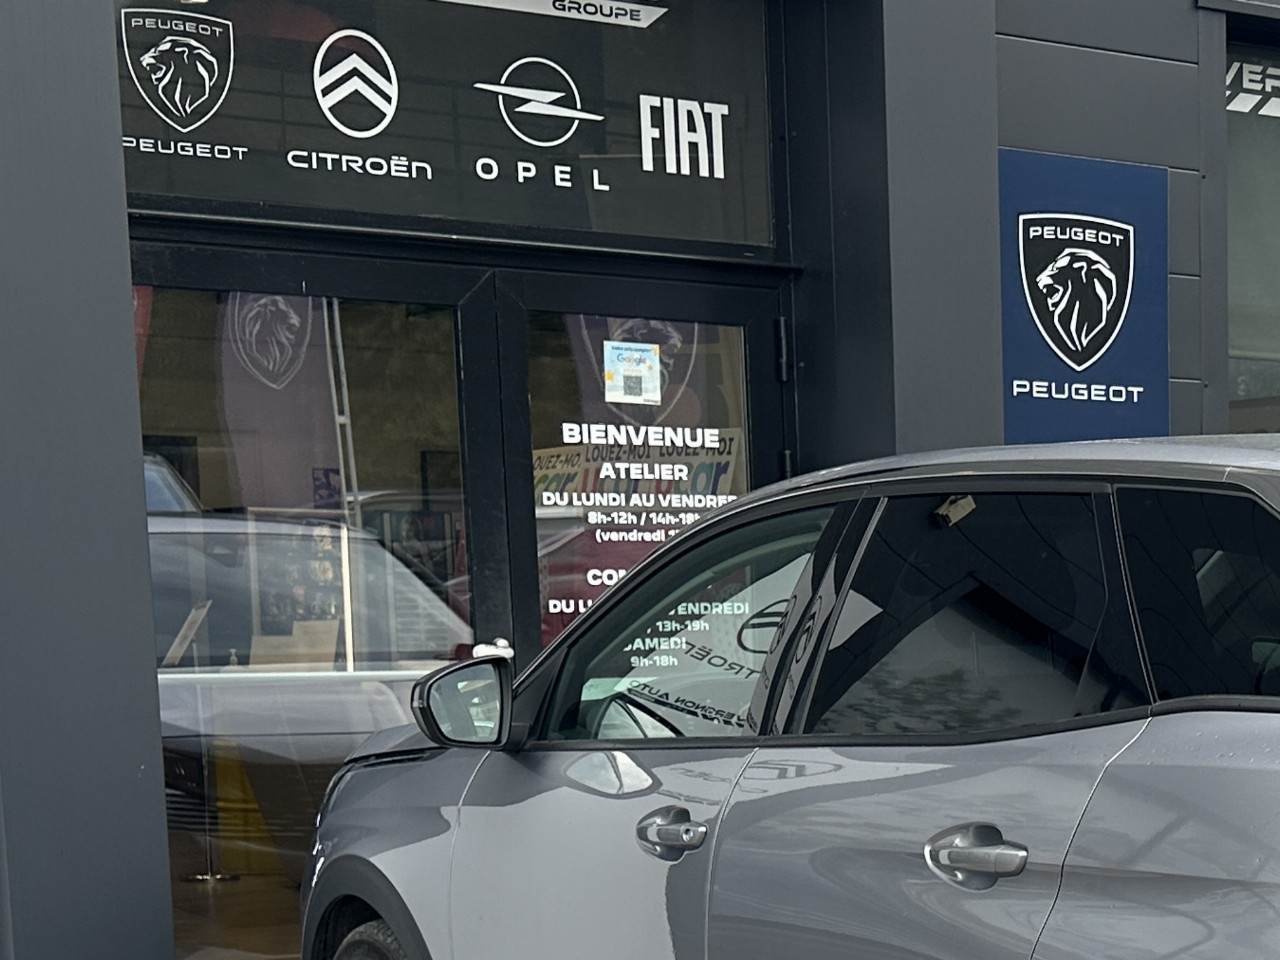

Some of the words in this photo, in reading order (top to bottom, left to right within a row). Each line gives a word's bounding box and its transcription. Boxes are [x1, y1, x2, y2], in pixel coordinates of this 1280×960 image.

[551, 0, 642, 22] GROUPE
[131, 18, 224, 37] PEUGEOT
[639, 94, 729, 180] FIAT
[122, 136, 249, 161] PEUGEOT
[475, 157, 610, 192] OPEL
[1029, 226, 1125, 247] PEUGEOT
[1012, 379, 1144, 403] PEUGEOT
[561, 422, 720, 449] BIENVENUE
[599, 461, 689, 481] ATELIER
[542, 491, 569, 507] DU
[572, 492, 626, 507] LUNDI
[629, 493, 655, 508] AU
[587, 511, 637, 525] 8h-12h
[548, 599, 575, 614] DU
[655, 620, 710, 632] 13h-19h
[630, 656, 678, 667] 9h-18h
